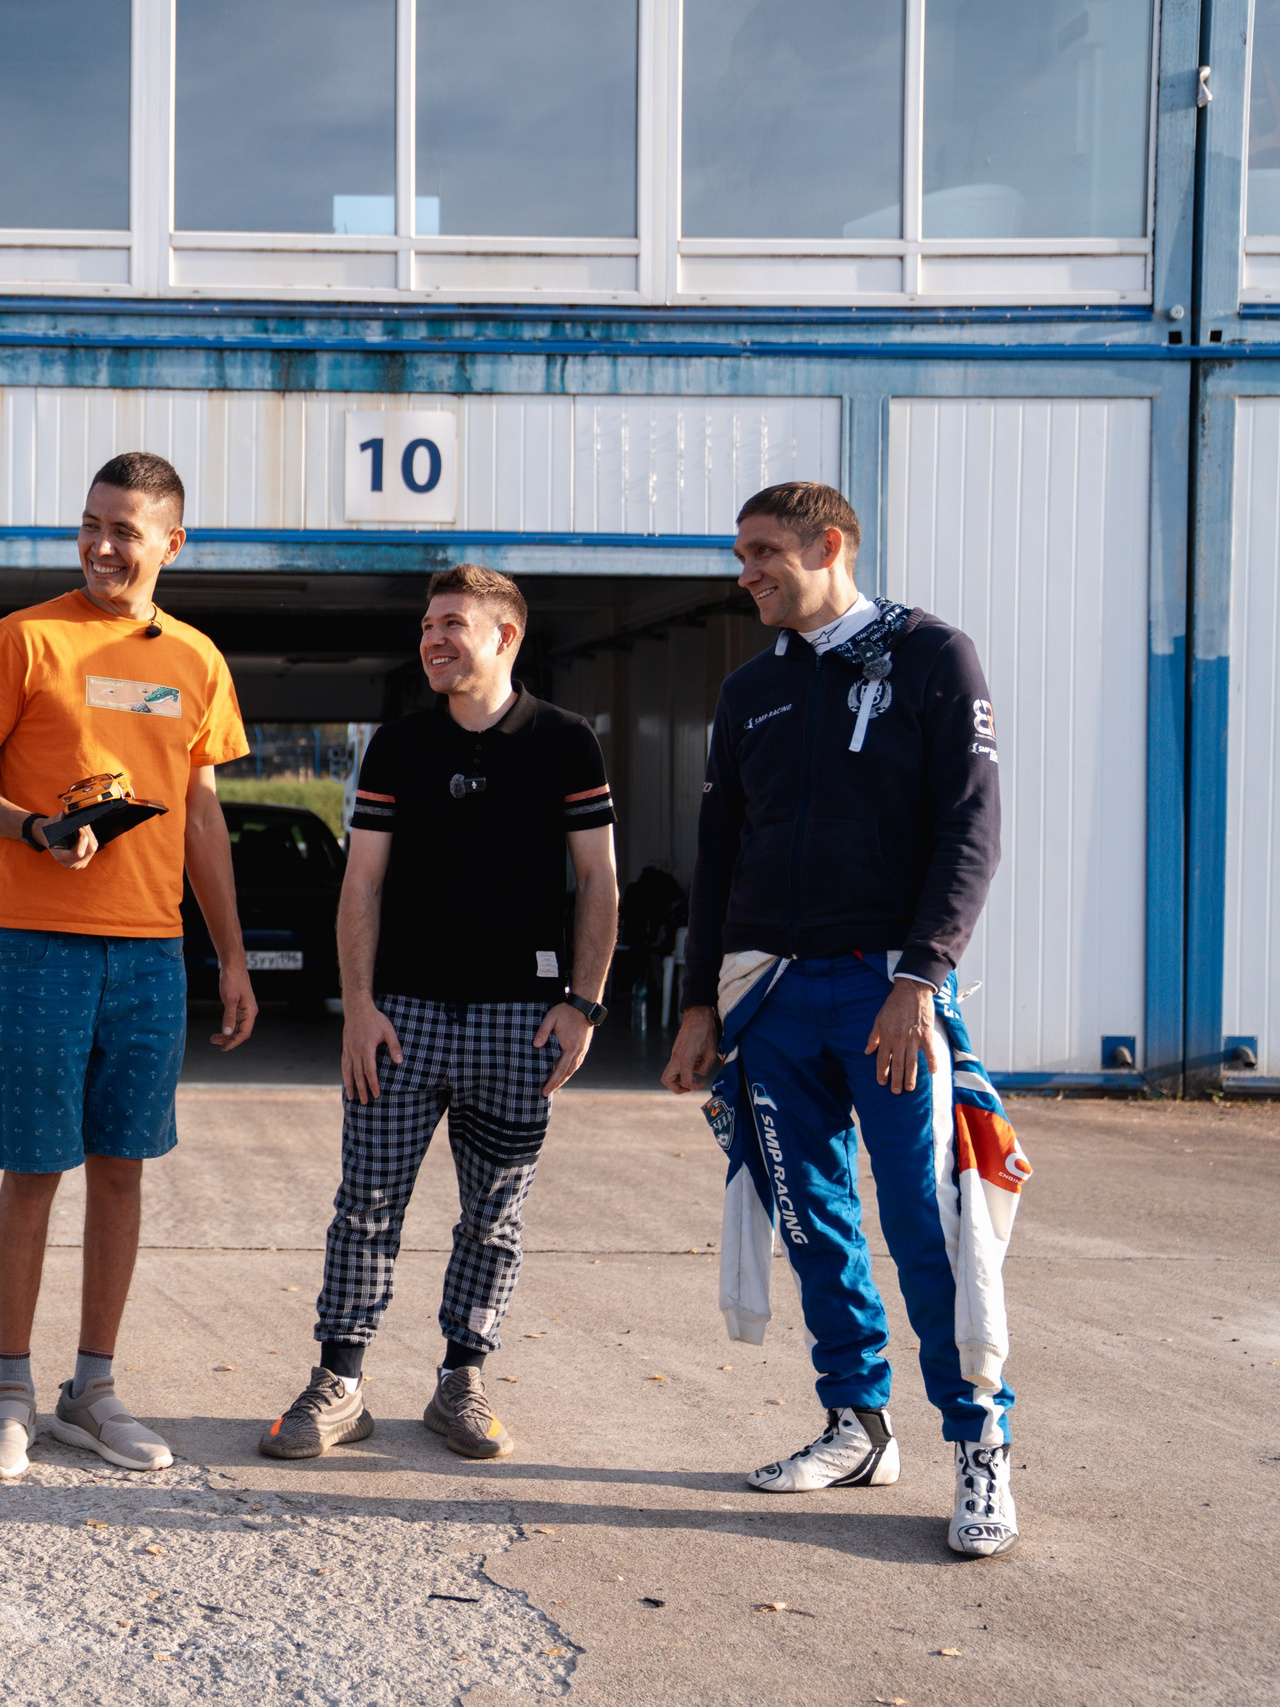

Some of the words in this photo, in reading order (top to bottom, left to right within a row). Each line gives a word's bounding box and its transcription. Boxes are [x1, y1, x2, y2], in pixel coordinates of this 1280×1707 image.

[359, 437, 442, 494] 10
[761, 1113, 783, 1163] SMP
[774, 1164, 809, 1245] RACING
